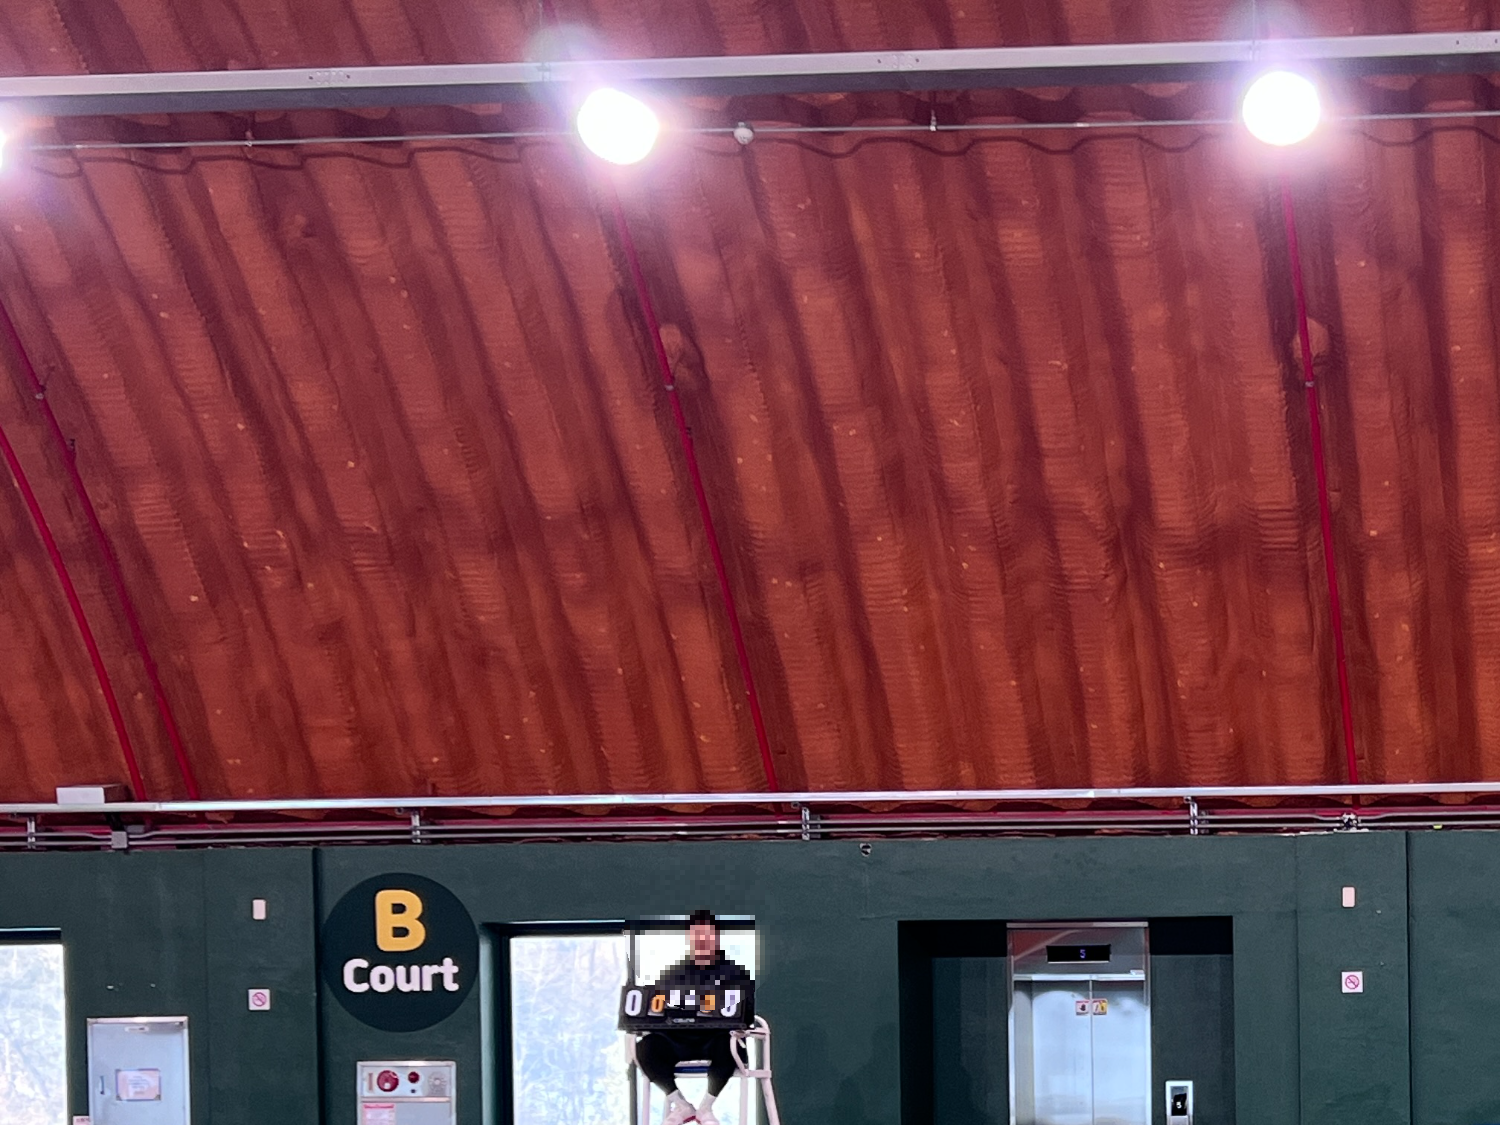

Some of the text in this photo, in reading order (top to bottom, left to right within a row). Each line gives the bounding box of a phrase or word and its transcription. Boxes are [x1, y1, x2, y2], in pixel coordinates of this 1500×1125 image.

[375, 889, 426, 952] B
[1080, 949, 1086, 959] 5
[343, 957, 459, 993] Court
[624, 989, 642, 1016] 0
